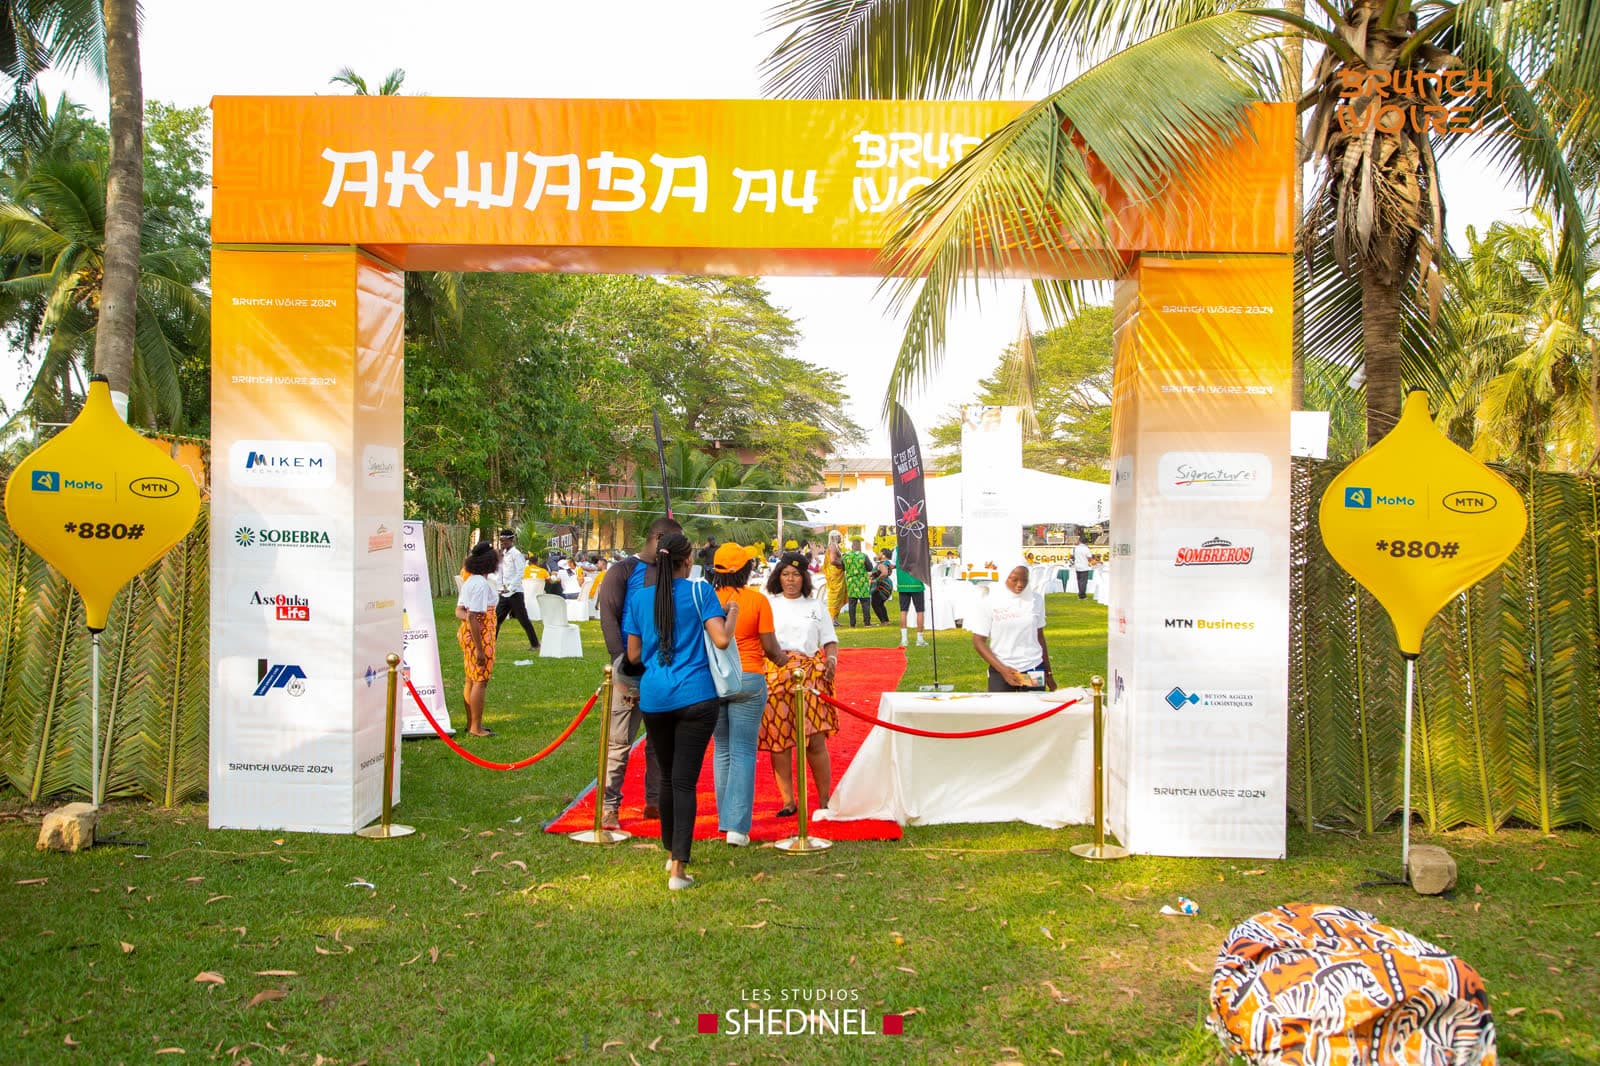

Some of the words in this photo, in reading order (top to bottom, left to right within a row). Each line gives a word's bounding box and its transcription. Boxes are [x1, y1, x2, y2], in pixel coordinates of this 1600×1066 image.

[321, 147, 708, 213] AKWABA
[310, 299, 337, 308] 2024
[1245, 306, 1274, 315] 2024
[245, 451, 324, 469] MIKEM
[64, 479, 103, 490] MoMo
[141, 483, 168, 493] MTN
[1376, 495, 1415, 506] MoMo
[1455, 497, 1484, 507] MTN
[259, 529, 331, 544] SOBEBRA
[1175, 547, 1253, 565] SOMBREROS
[279, 607, 306, 619] Life
[1164, 618, 1194, 629] MTN
[1197, 618, 1255, 630] Business
[306, 765, 334, 774] 2024
[1237, 789, 1267, 799] 2024
